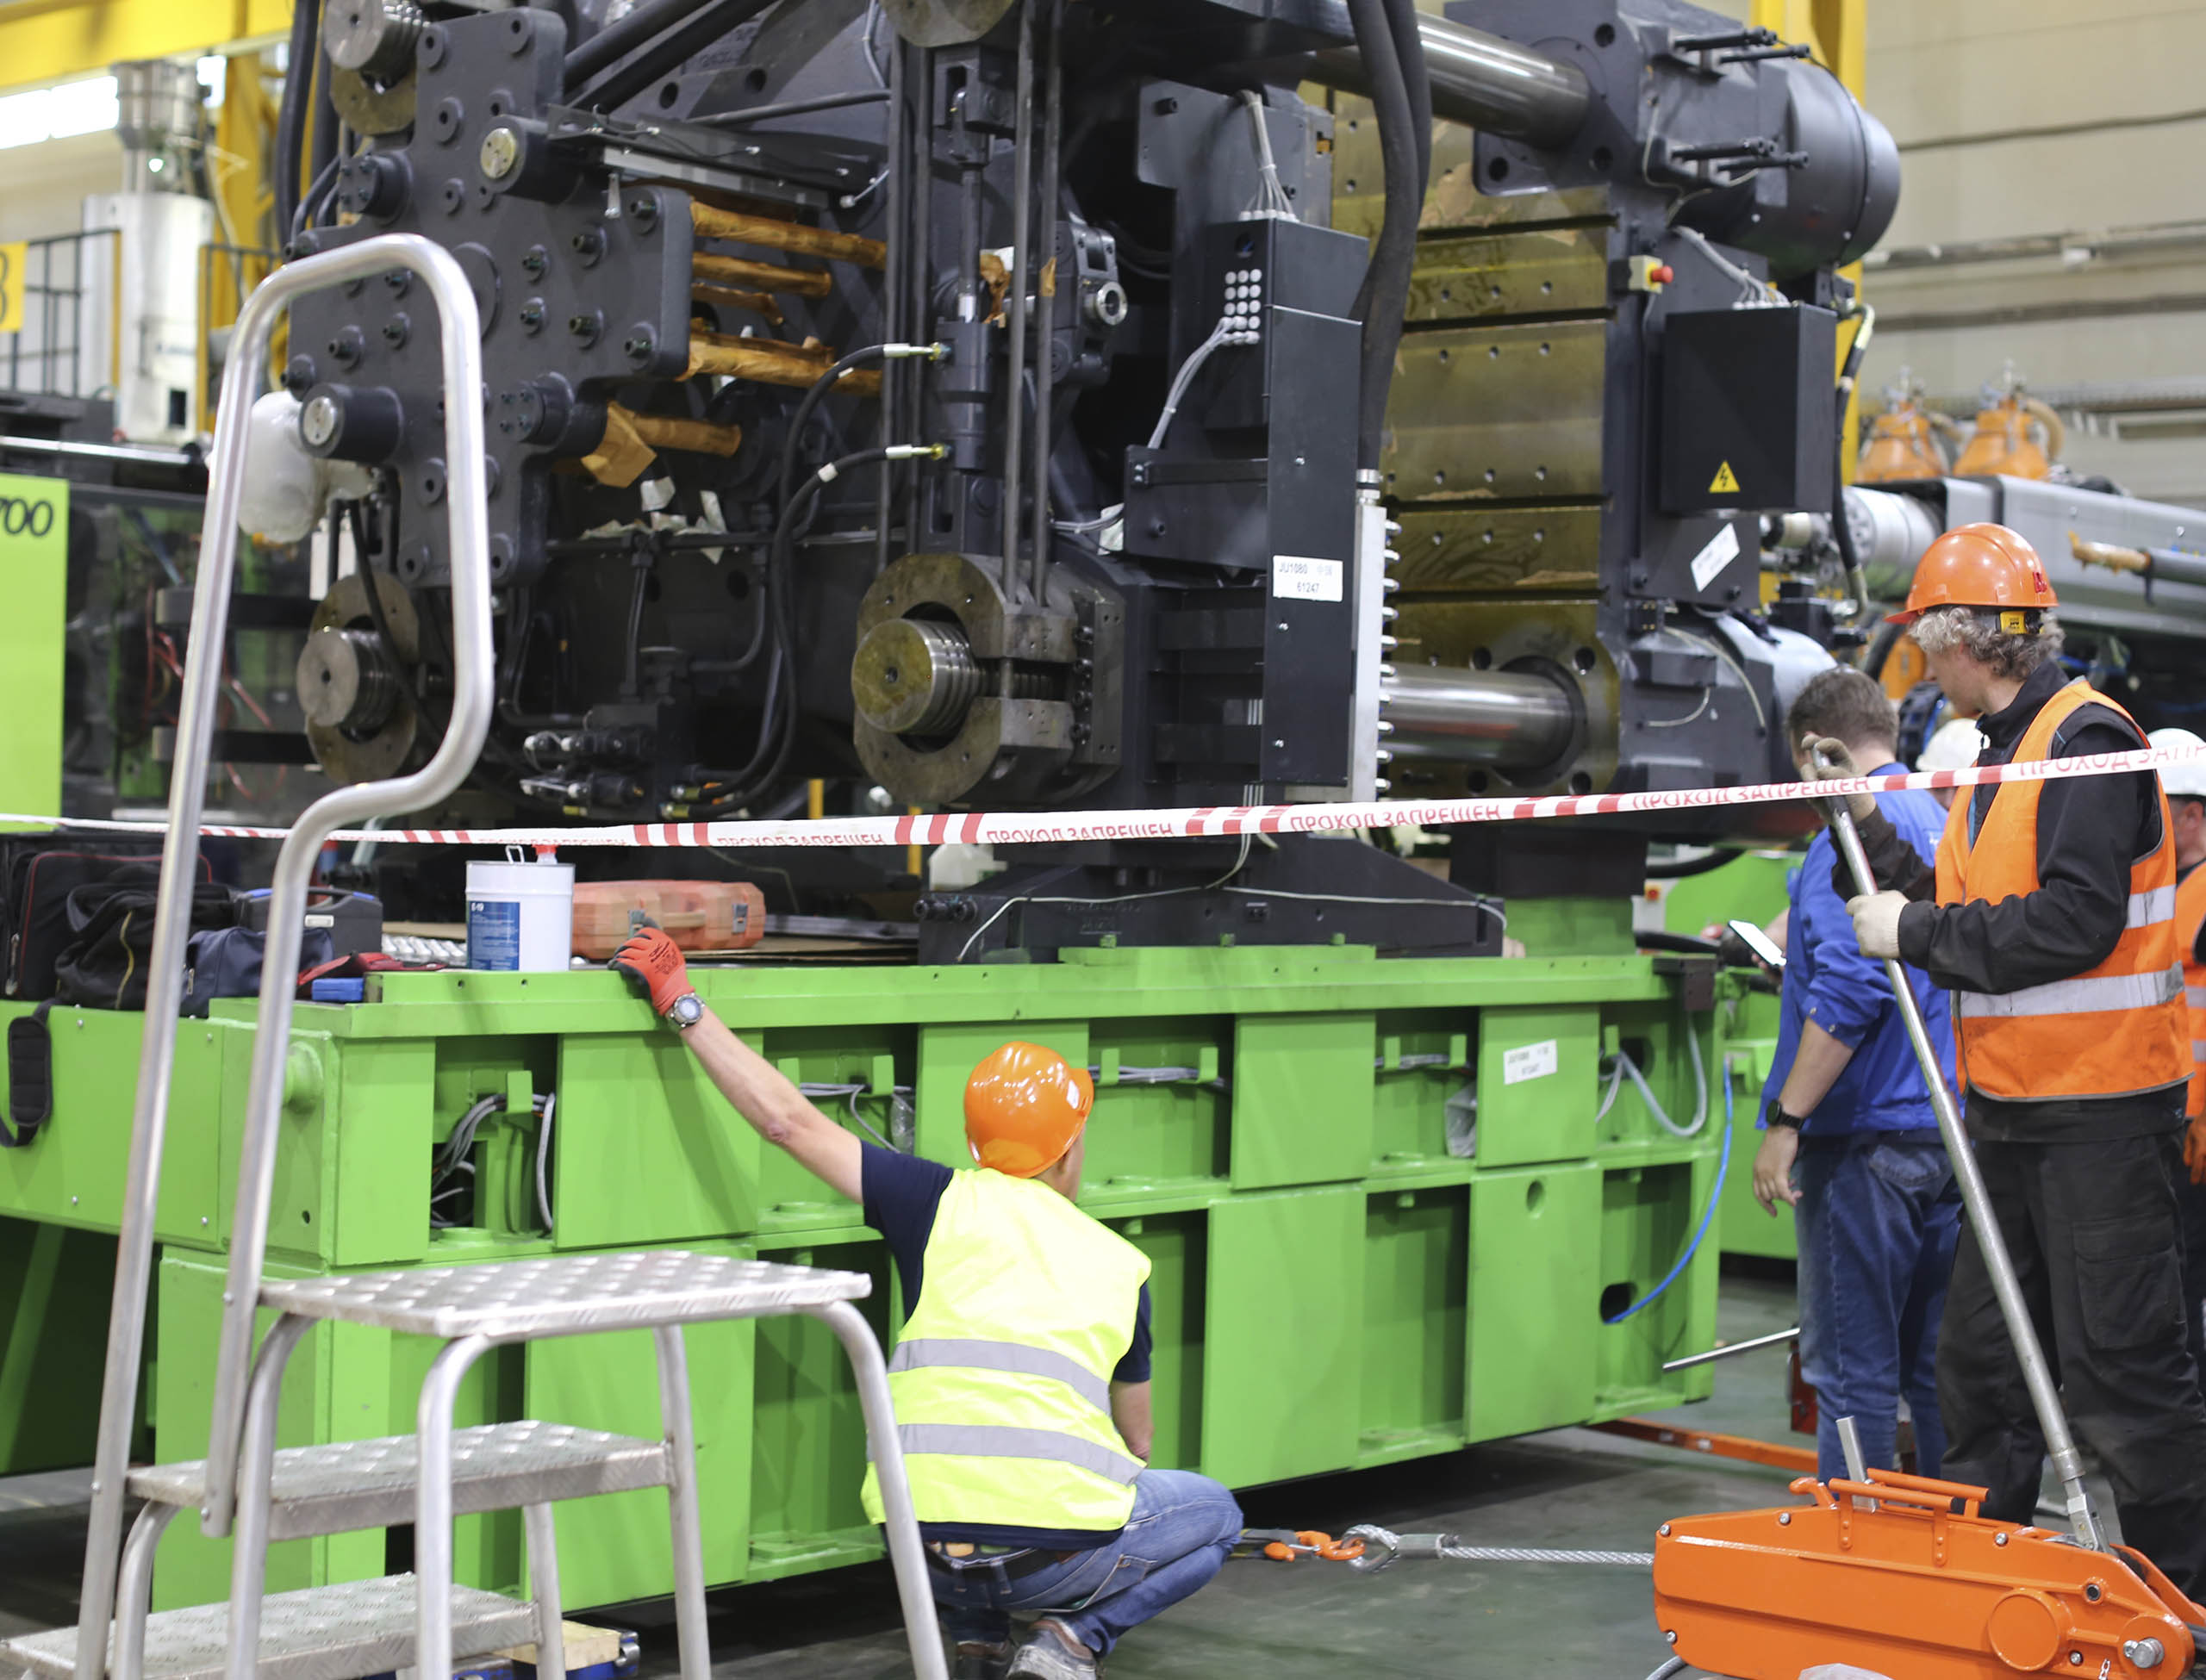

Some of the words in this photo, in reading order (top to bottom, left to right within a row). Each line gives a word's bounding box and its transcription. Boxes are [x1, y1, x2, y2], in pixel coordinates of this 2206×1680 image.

[2020, 752, 2131, 776] ПРОХОД
[1632, 788, 1733, 809] ПРОХОД
[1736, 777, 1872, 802] ЗАПРЕЩЕН
[1290, 813, 1377, 831] ПРОХОД
[1382, 805, 1503, 827] ЗАПРЕЩЕН
